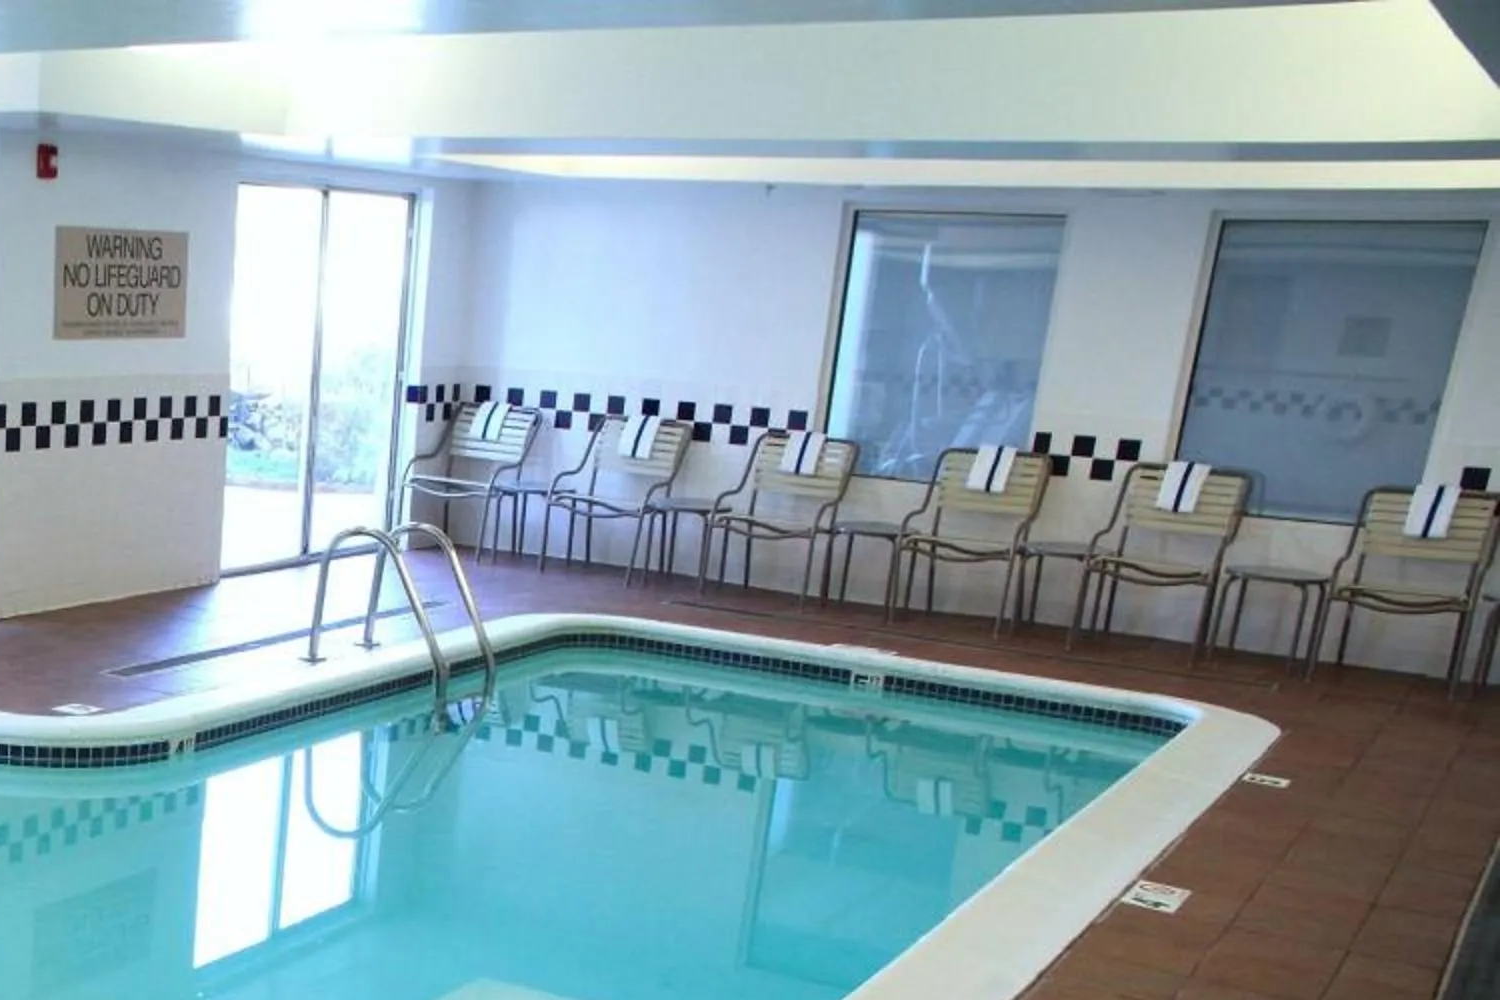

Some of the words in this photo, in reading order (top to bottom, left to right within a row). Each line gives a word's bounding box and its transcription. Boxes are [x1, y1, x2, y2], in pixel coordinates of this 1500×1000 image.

[86, 233, 163, 261] WARNING
[63, 264, 89, 288] NO
[95, 264, 181, 289] LIFEGUARD
[86, 292, 111, 317] ON
[117, 293, 160, 317] DUTY
